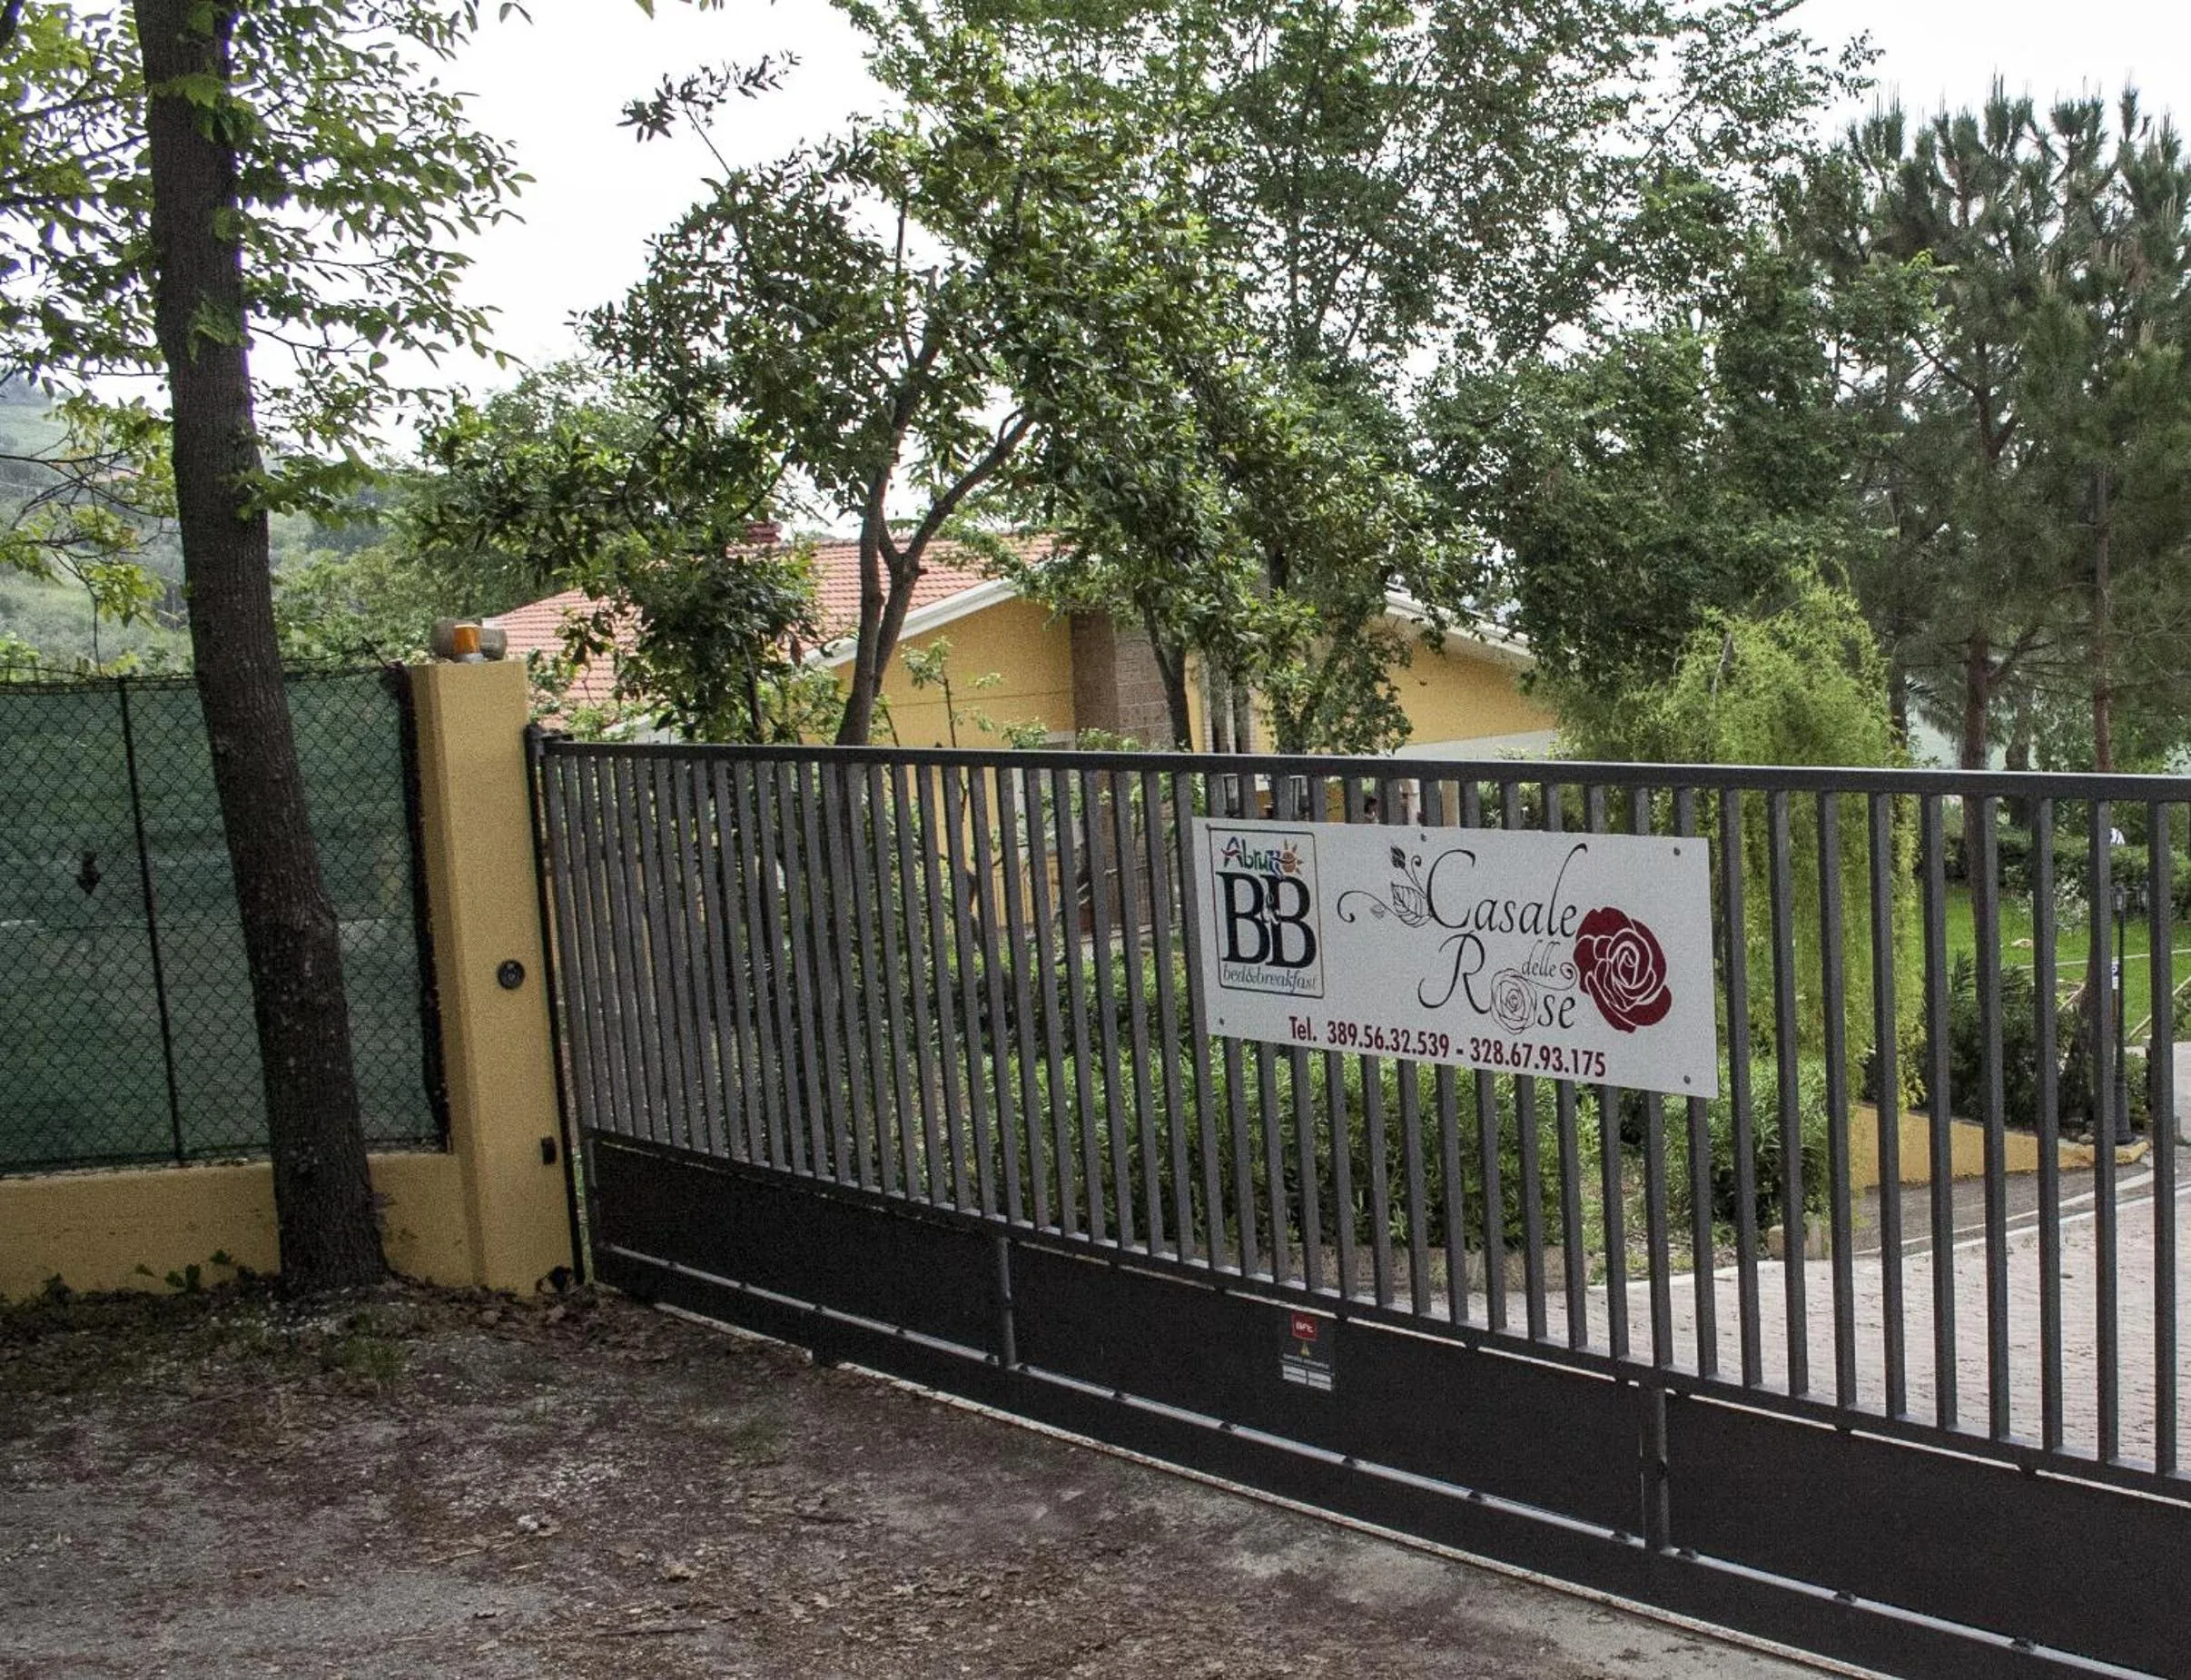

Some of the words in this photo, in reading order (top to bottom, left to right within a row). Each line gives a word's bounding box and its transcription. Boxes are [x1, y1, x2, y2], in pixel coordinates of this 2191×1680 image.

[1426, 843, 1587, 938] Casale
[1521, 939, 1561, 978] delle
[1288, 1016, 1317, 1042] Tel.
[1327, 1021, 1450, 1058] 389.56.32.539
[1470, 1037, 1605, 1077] 328.67.93.175
